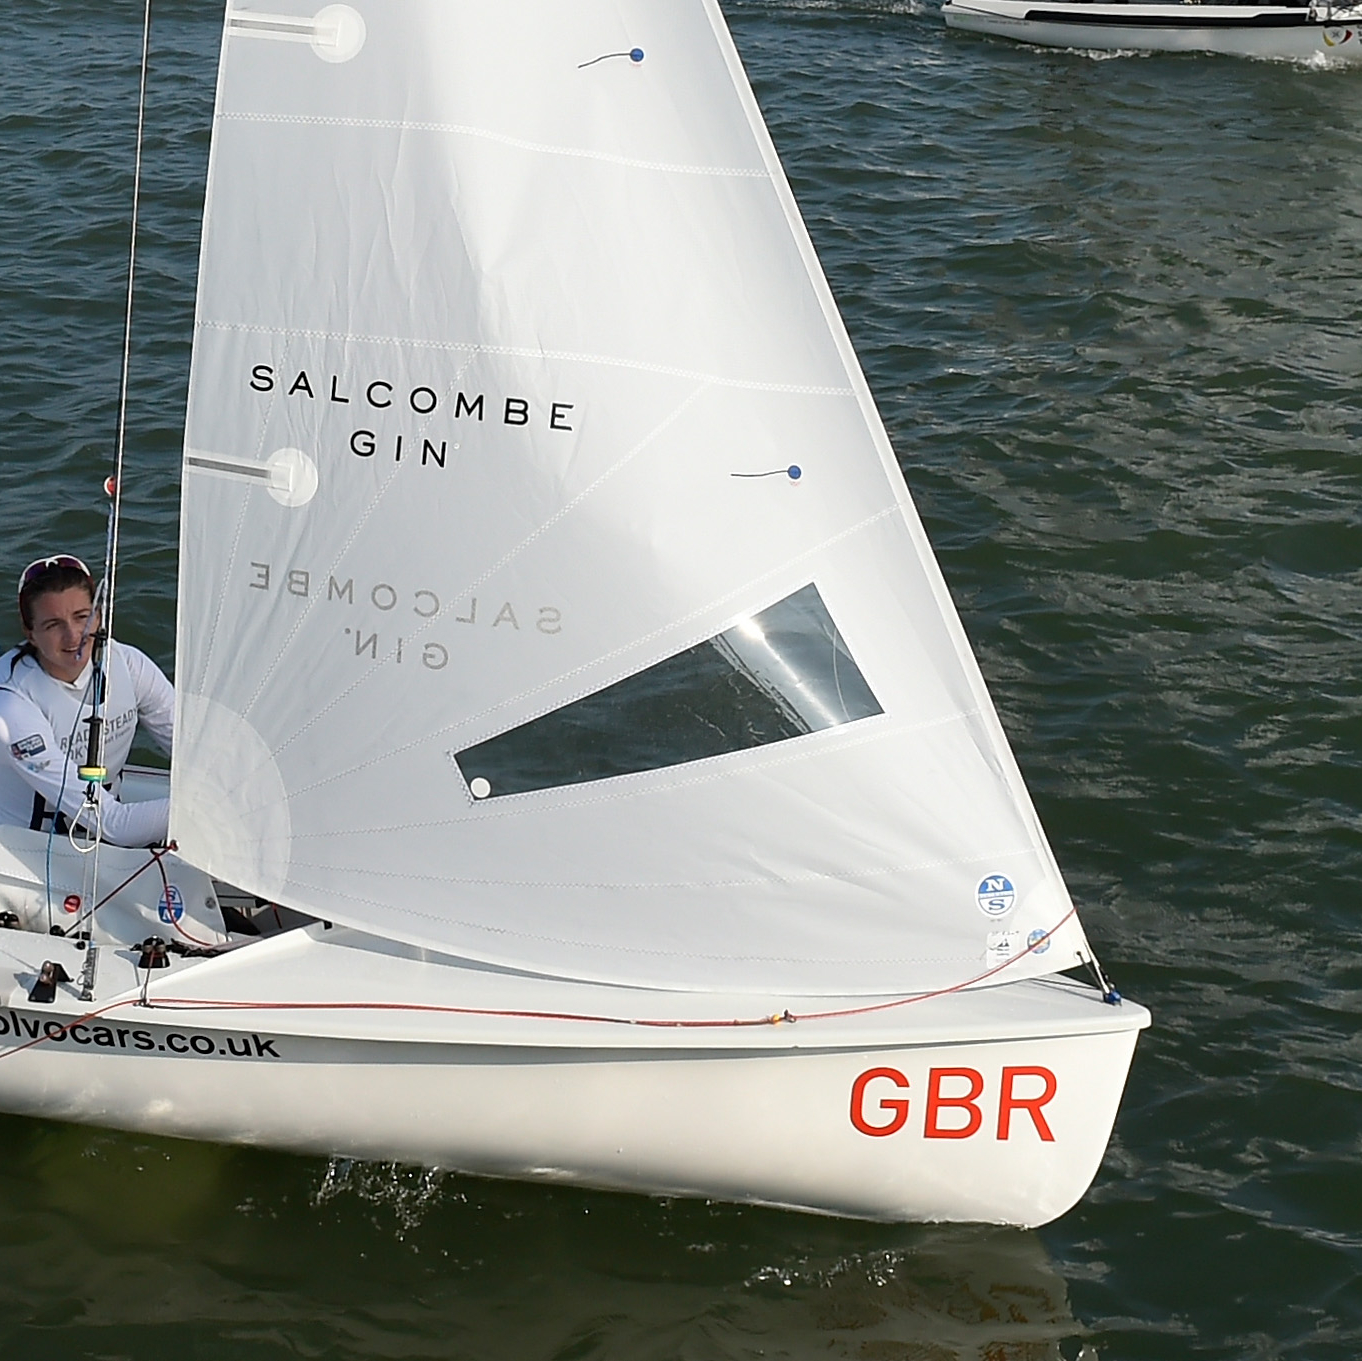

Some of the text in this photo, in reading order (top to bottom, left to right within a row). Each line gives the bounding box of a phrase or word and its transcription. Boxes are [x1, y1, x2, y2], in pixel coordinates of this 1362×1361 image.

[249, 364, 575, 432] SALCOMBE
[349, 430, 448, 468] GIN
[849, 1065, 1058, 1142] GBR
